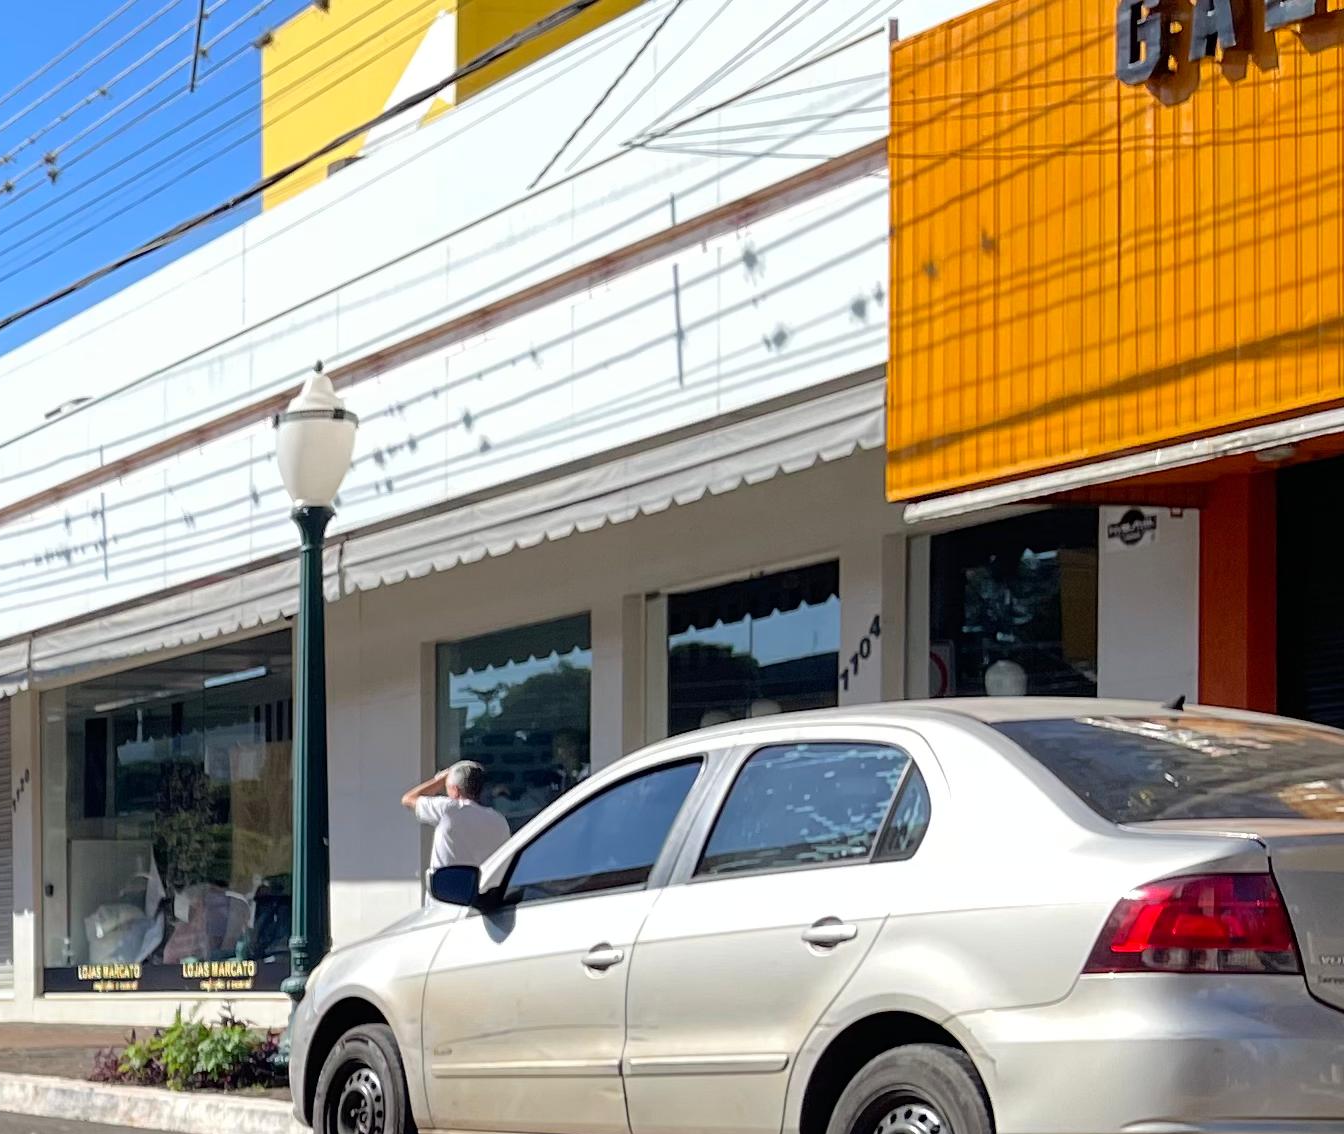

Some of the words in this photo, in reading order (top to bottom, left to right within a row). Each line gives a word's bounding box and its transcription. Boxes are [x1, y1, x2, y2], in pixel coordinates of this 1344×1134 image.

[839, 613, 880, 691] 1104
[77, 964, 102, 980] LOJAS
[102, 963, 141, 979] MARCATO
[182, 962, 210, 978] LOJAS
[210, 961, 256, 977] MARCATO
